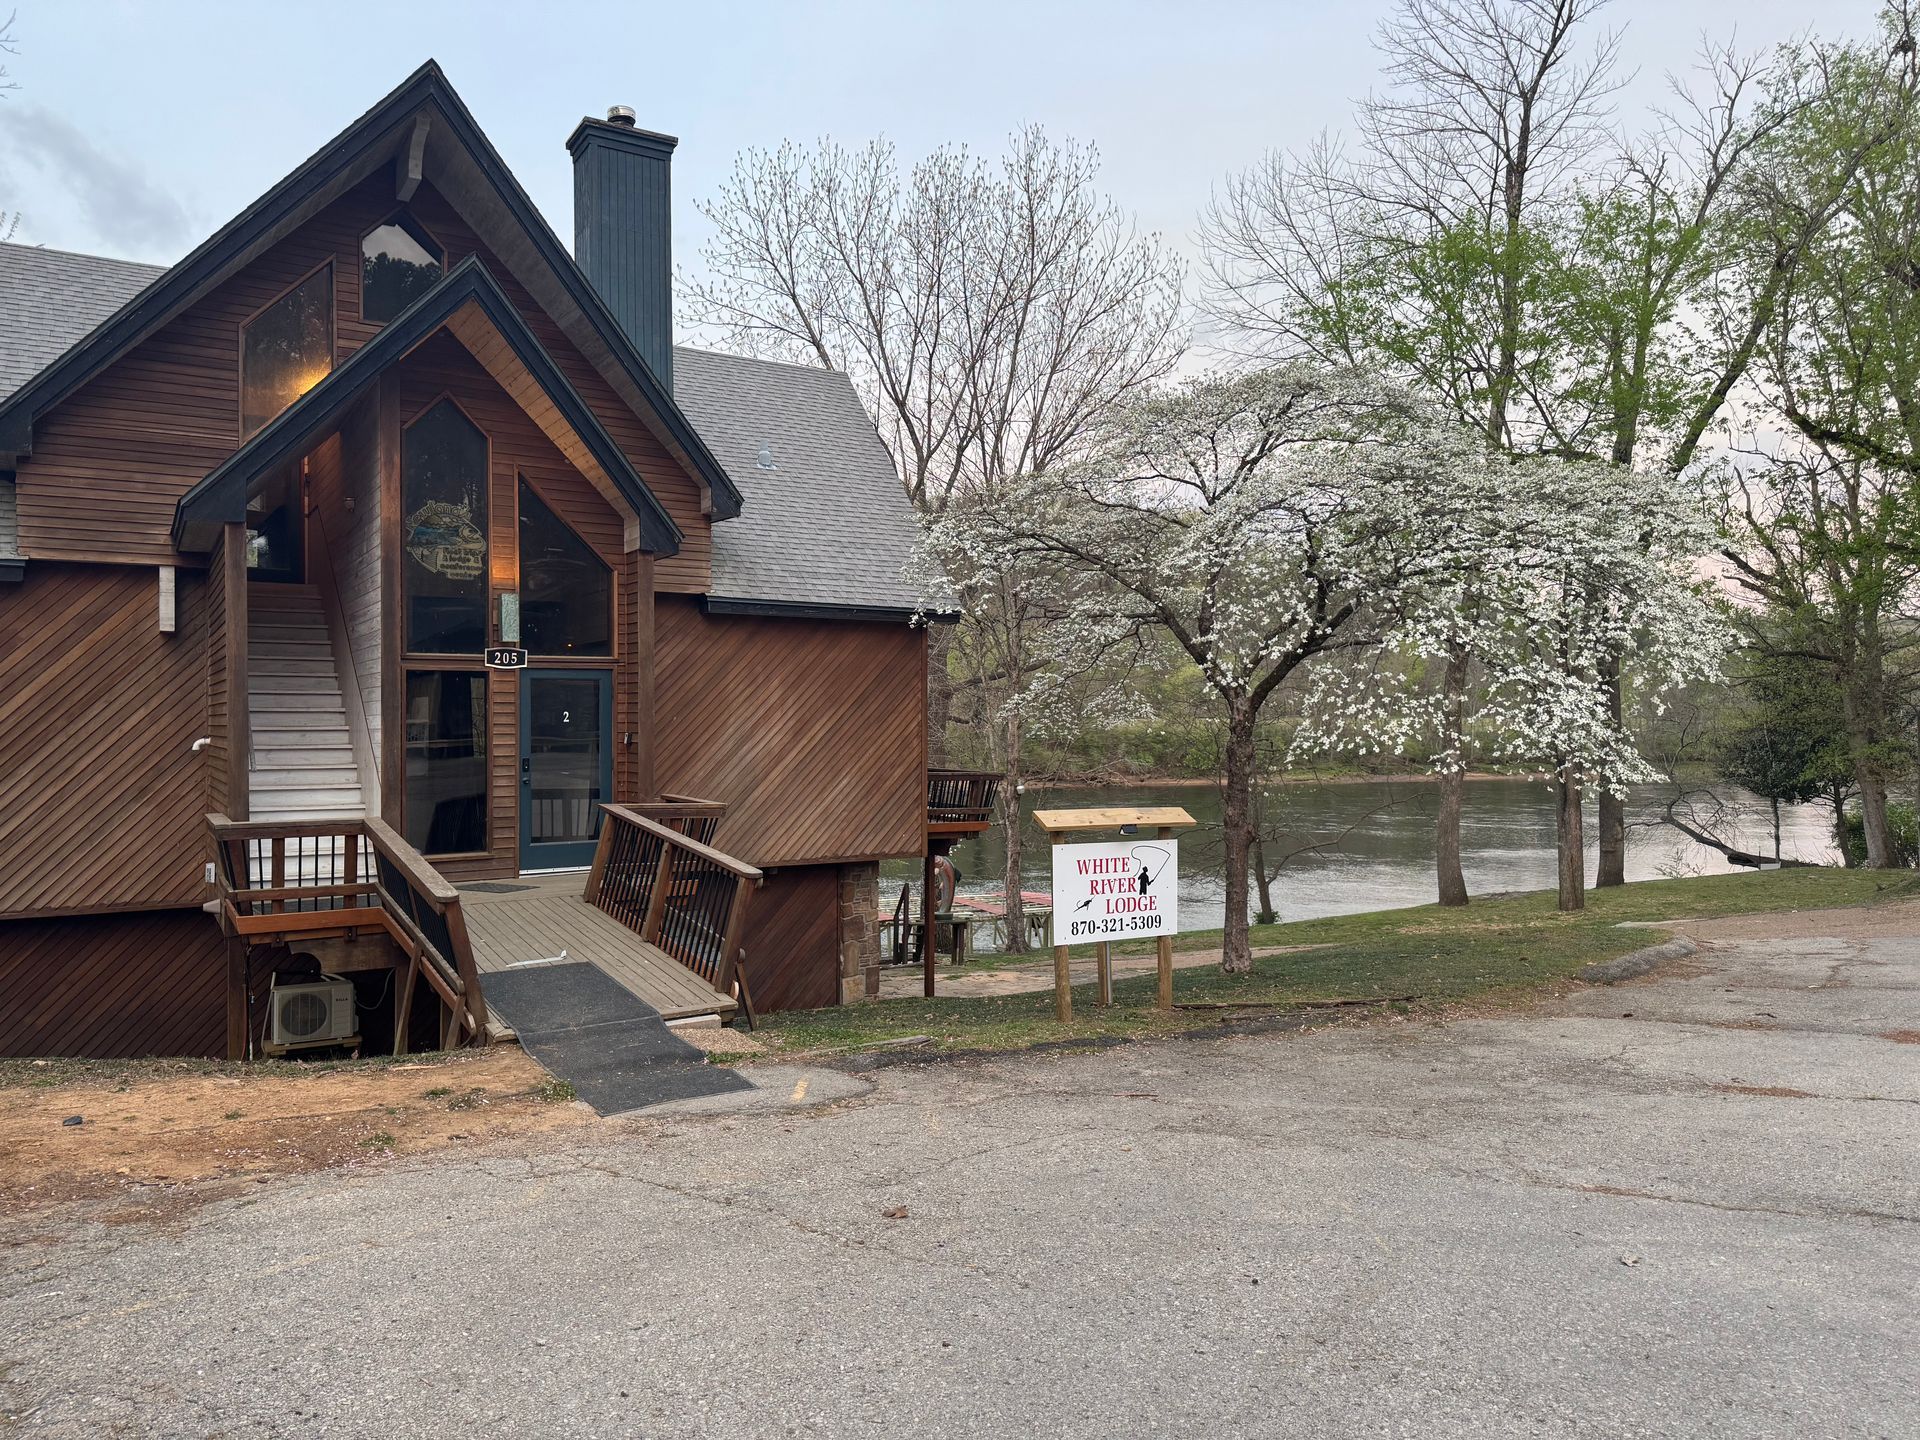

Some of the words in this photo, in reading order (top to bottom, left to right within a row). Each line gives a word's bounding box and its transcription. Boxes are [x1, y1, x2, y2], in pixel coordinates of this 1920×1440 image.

[494, 652, 518, 664] 205
[563, 711, 570, 723] 2
[1076, 857, 1130, 876] WHITE
[1090, 877, 1137, 895] RIVER
[1106, 895, 1157, 914] LODGE
[1071, 914, 1162, 936] 870-321-5309
